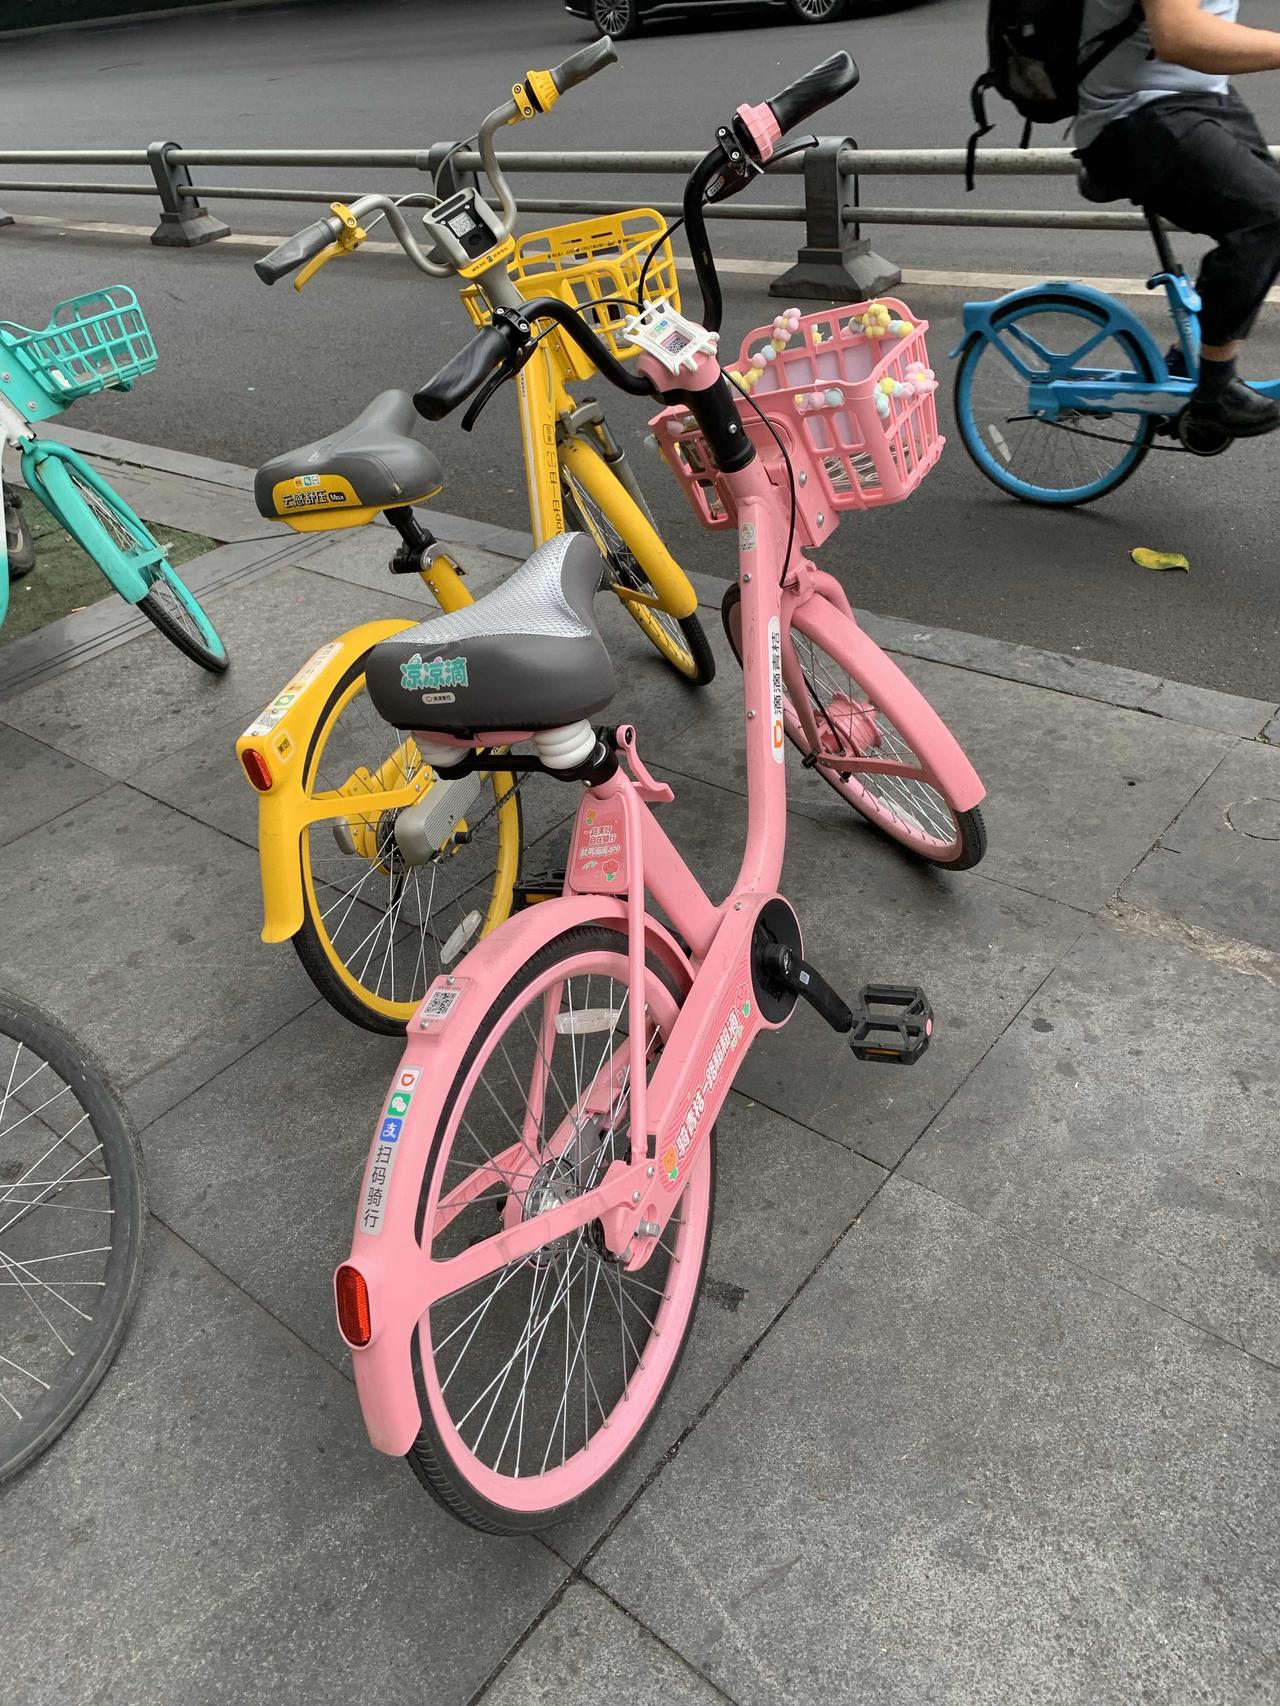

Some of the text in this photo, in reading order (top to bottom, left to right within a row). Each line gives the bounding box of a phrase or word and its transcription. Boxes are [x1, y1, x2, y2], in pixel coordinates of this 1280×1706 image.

[283, 490, 345, 508] 云感舒压 Max
[400, 656, 469, 690] 凉凉滴
[363, 1145, 392, 1228] 扫码骑行
